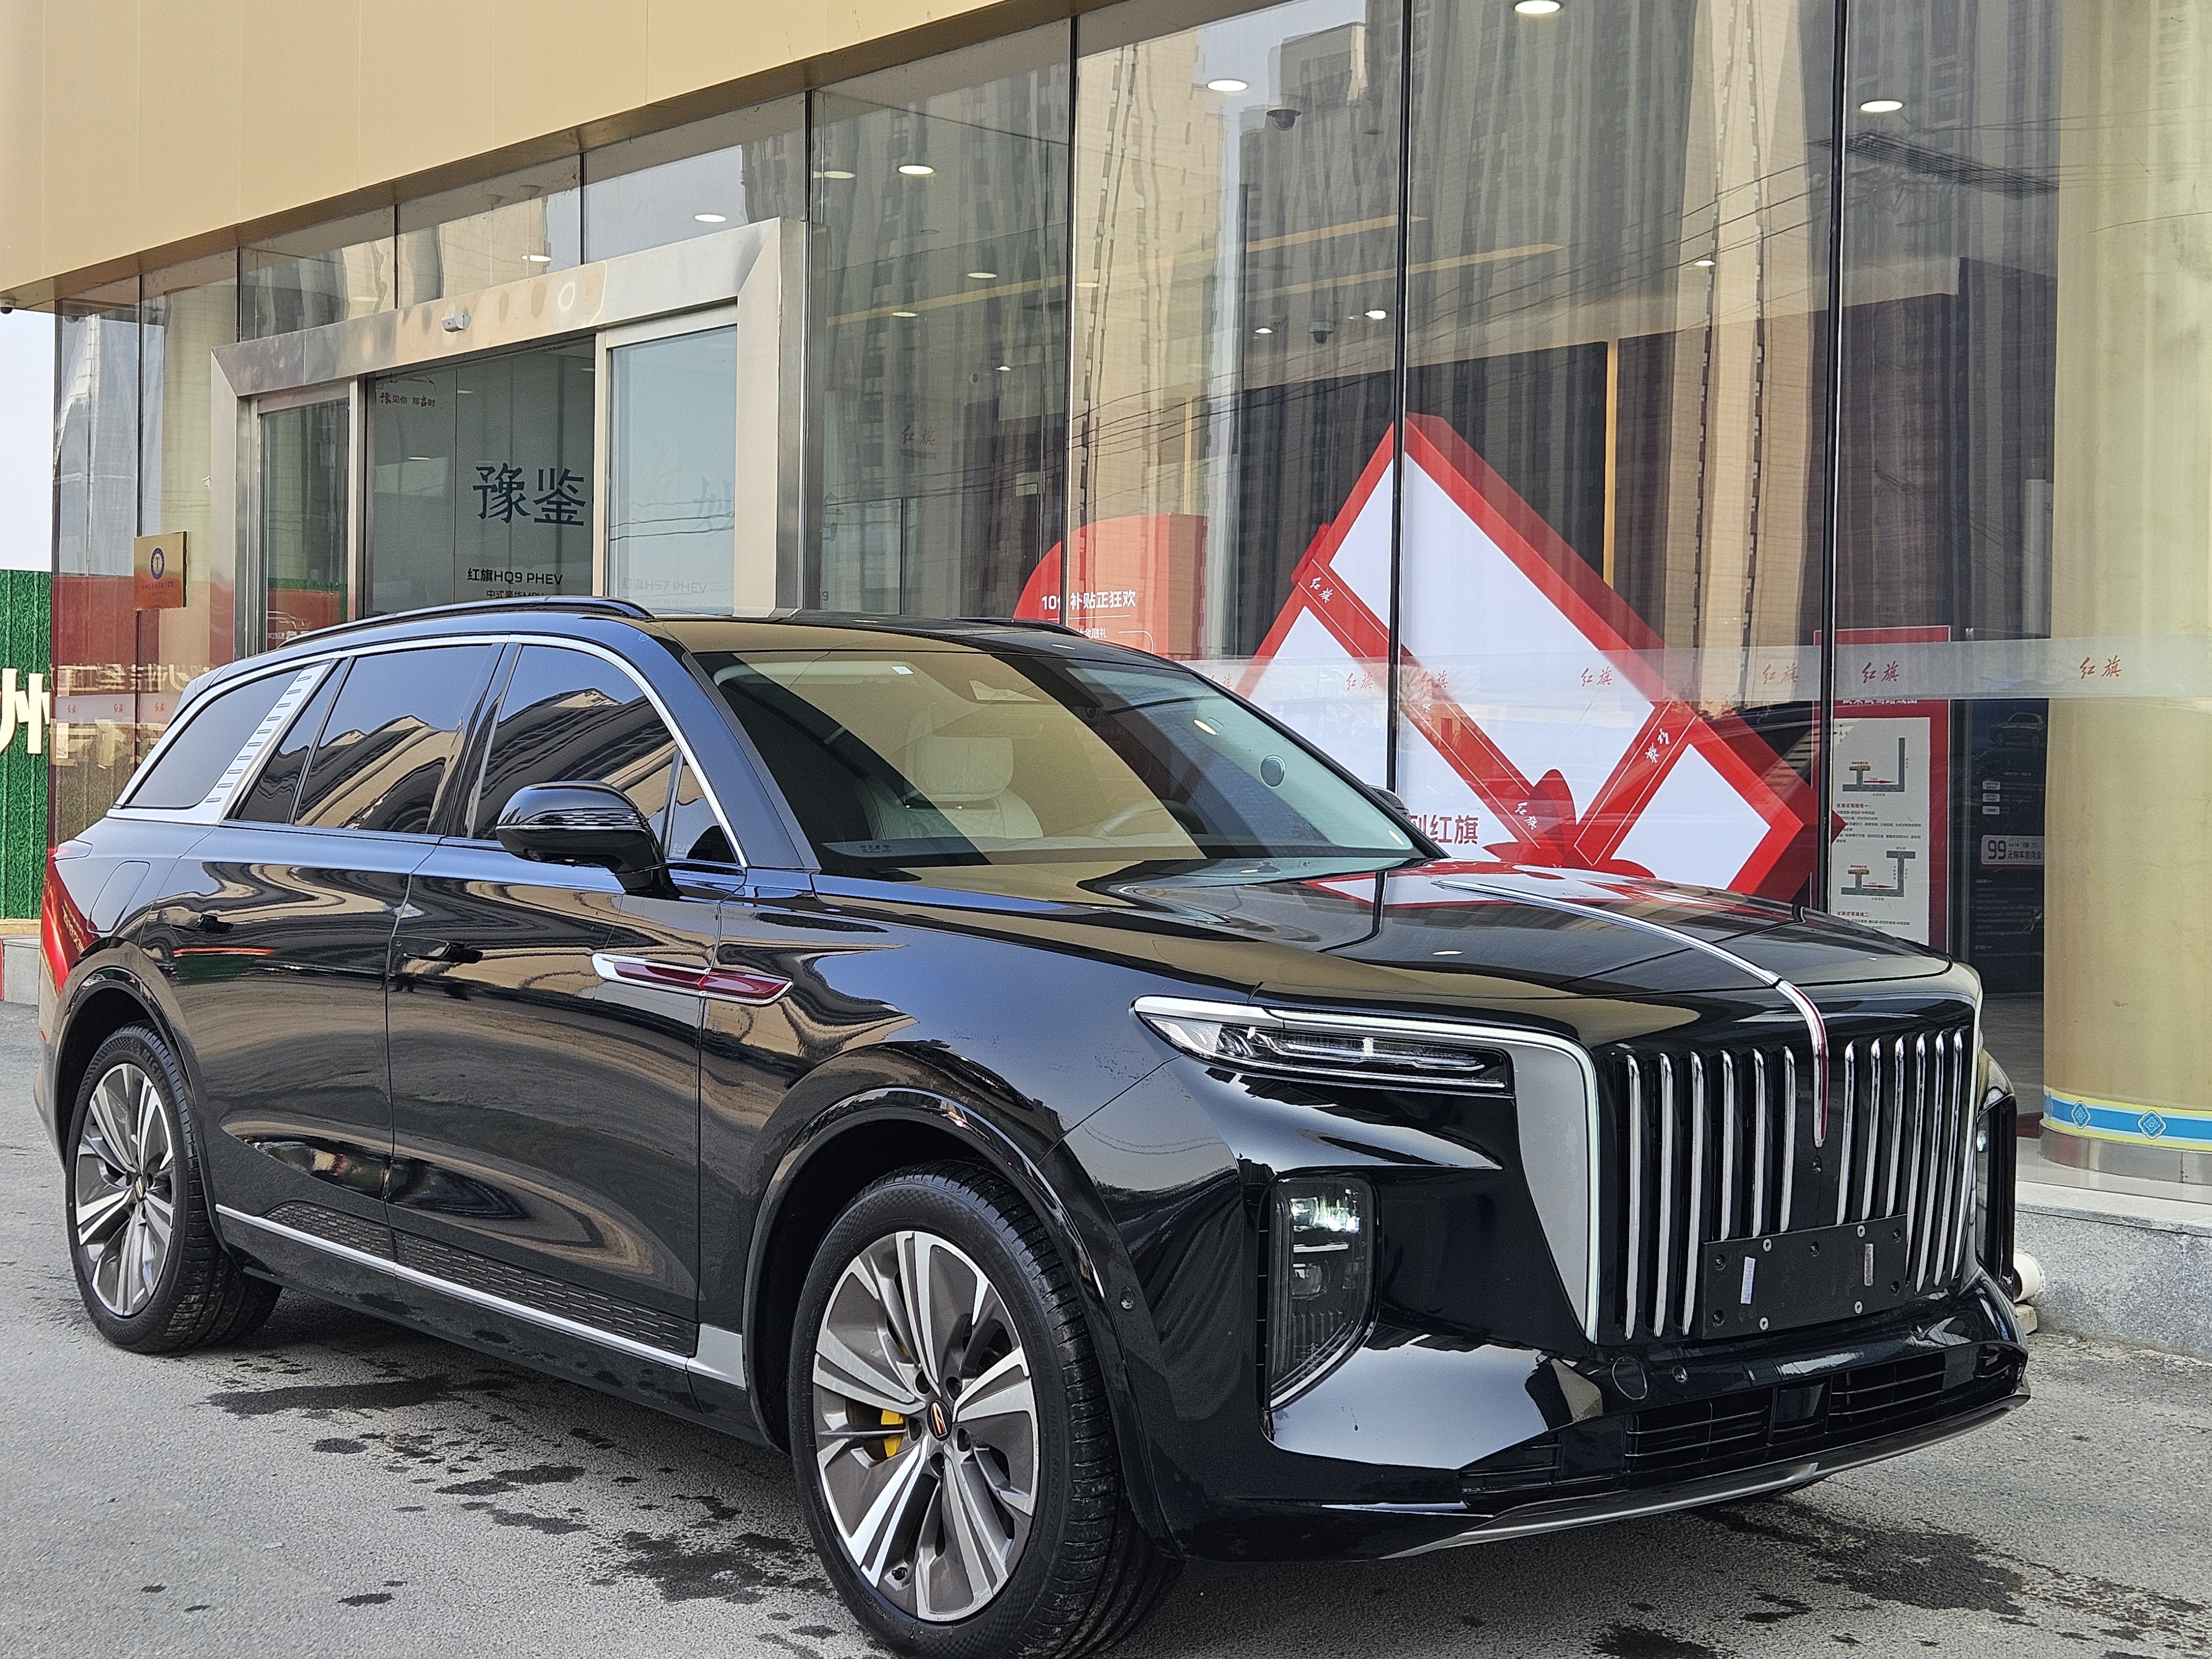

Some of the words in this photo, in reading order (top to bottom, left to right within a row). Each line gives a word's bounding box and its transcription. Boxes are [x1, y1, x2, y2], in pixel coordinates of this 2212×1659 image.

[902, 425, 935, 445] 红旗
[472, 462, 586, 526] 豫鉴
[467, 567, 523, 584] 红旗HQ9
[527, 572, 563, 585] PHEV
[1309, 577, 1332, 604] 红旗
[1580, 666, 1613, 687] 红旗
[1762, 662, 1798, 685] 红旗
[1862, 661, 1900, 684] 红旗
[2079, 655, 2122, 679] 红旗
[1346, 671, 1374, 691] 红旗
[1420, 670, 1448, 689] 红旗
[1514, 801, 1538, 830] 红旗
[1987, 839, 2007, 860] 99
